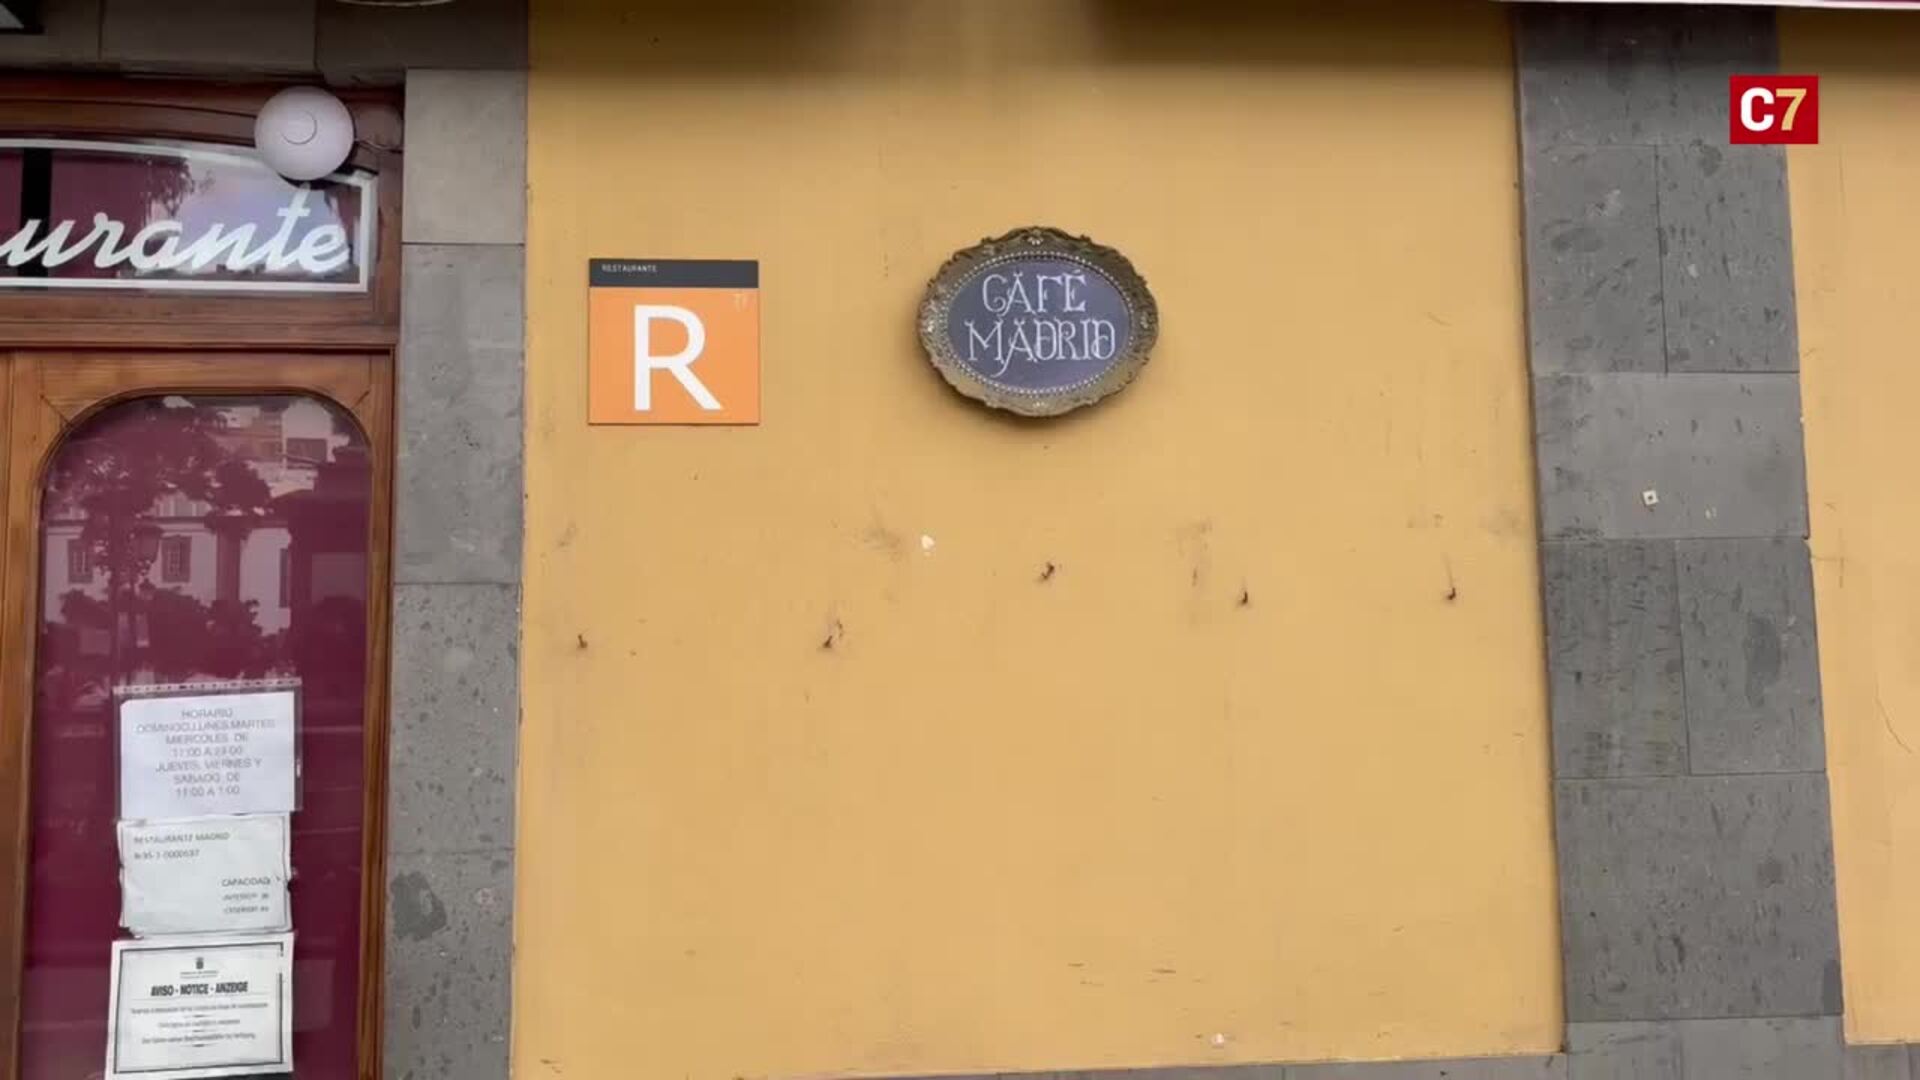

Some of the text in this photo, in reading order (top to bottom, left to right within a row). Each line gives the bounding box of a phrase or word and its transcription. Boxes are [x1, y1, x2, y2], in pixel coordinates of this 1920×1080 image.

[601, 263, 658, 273] RESTAURANTE
[982, 269, 1087, 317] CAFÉ
[634, 304, 723, 411] R
[964, 317, 1116, 378] MADRID
